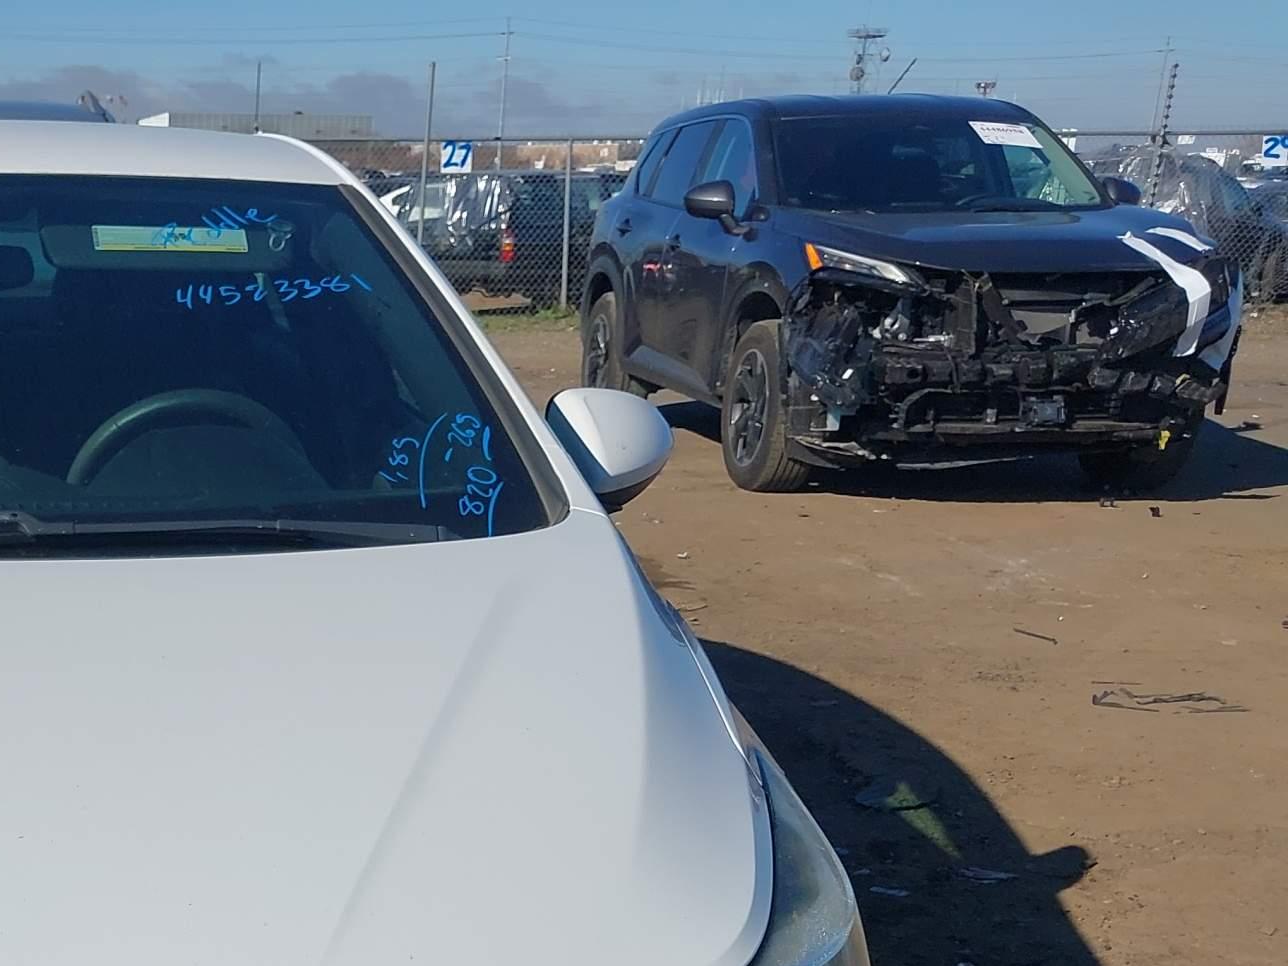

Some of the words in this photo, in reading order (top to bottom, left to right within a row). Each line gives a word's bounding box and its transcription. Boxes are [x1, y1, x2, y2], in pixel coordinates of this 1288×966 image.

[442, 139, 472, 169] 27
[175, 273, 373, 310] 44523381
[458, 465, 497, 516] 820
